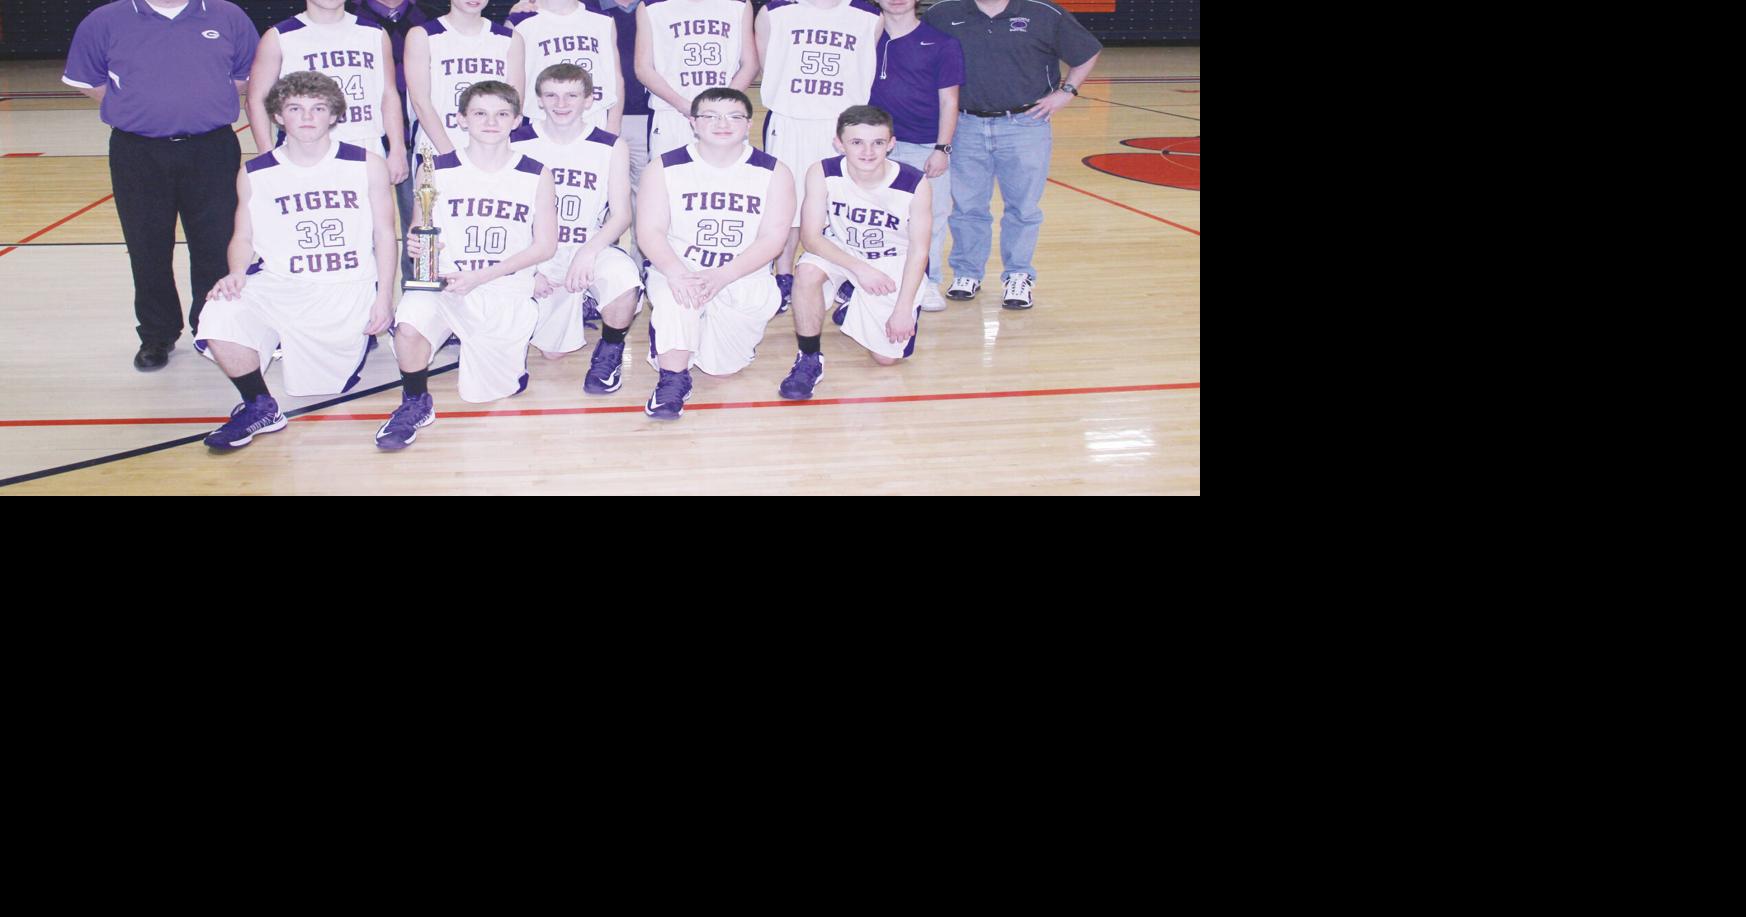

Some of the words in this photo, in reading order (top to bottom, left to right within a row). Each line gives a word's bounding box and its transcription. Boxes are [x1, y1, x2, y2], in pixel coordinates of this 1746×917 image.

[669, 19, 731, 38] TIGER
[791, 29, 857, 51] TIGER
[538, 35, 599, 57] TIGER
[683, 42, 722, 66] 33
[303, 50, 374, 71] TIGER
[441, 57, 505, 76] TIGER
[800, 50, 841, 76] 55
[330, 74, 365, 101] 4
[680, 70, 727, 87] CUBS
[790, 78, 844, 96] CUBS
[551, 167, 597, 191] GER
[275, 190, 360, 215] TIGER
[447, 198, 530, 223] TIGER
[555, 194, 581, 222] 0
[682, 192, 761, 214] TIGER
[295, 218, 345, 250] 32
[464, 225, 508, 254] 10
[558, 225, 588, 244] BS
[696, 218, 744, 248] 25
[846, 226, 884, 249] 12
[289, 250, 360, 274] CUBS
